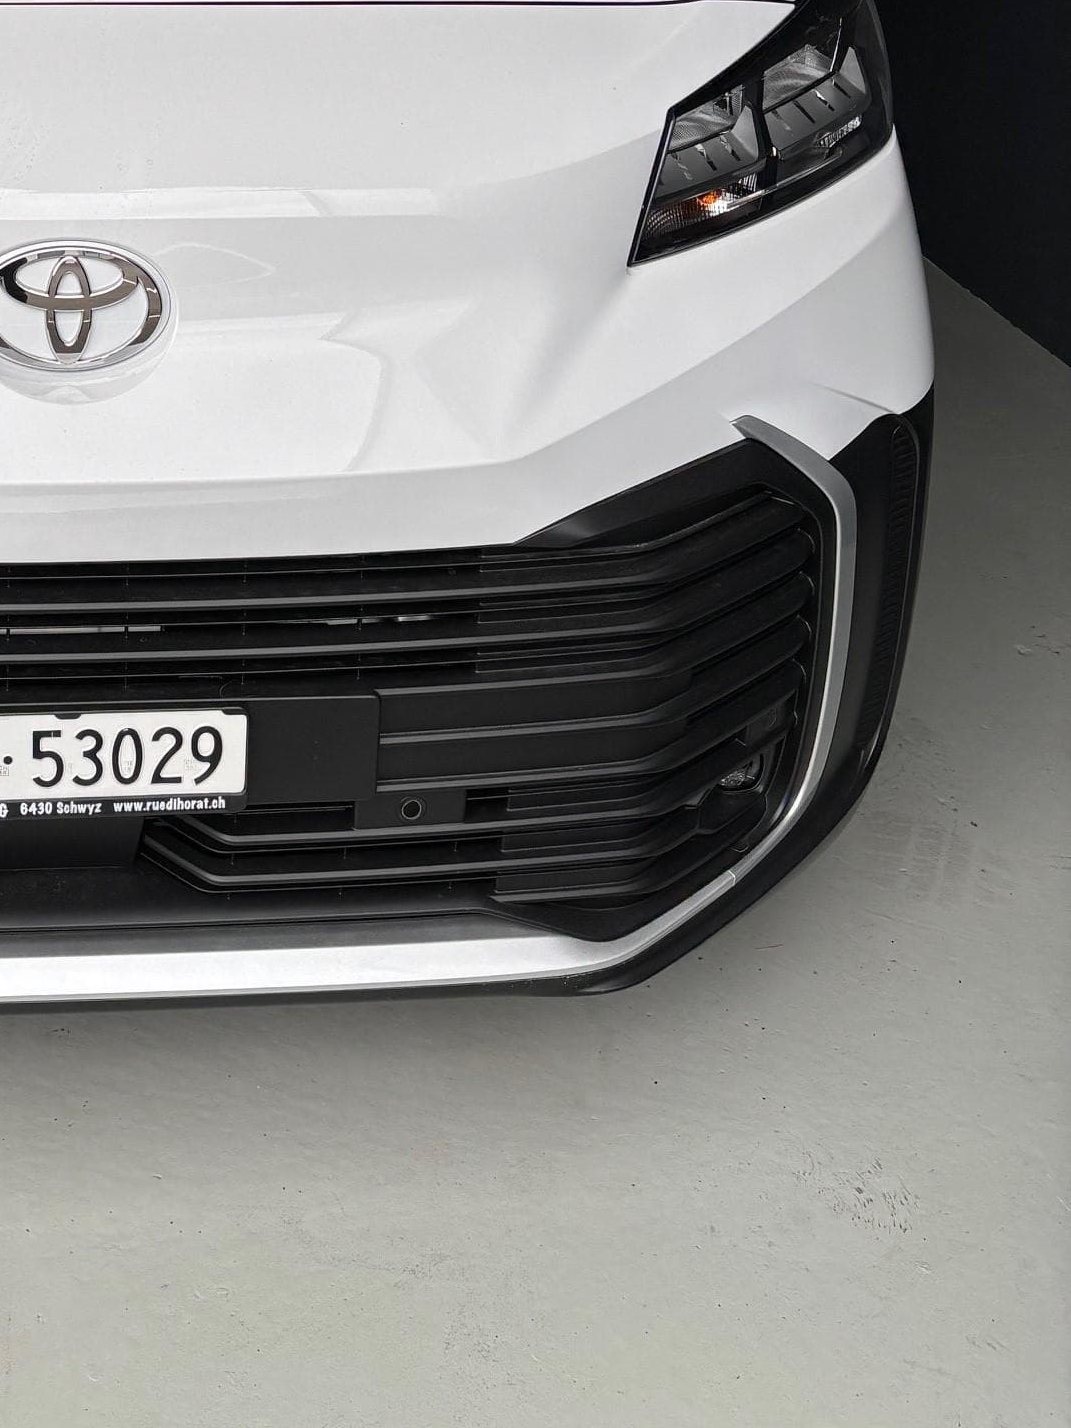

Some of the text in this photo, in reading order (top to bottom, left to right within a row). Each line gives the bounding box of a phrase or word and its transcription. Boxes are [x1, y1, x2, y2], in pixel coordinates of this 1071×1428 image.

[32, 725, 223, 788] 53029
[20, 802, 53, 816] 6430
[56, 800, 102, 815] Schwyz
[113, 796, 226, 813] www.ruedihorat.ch
